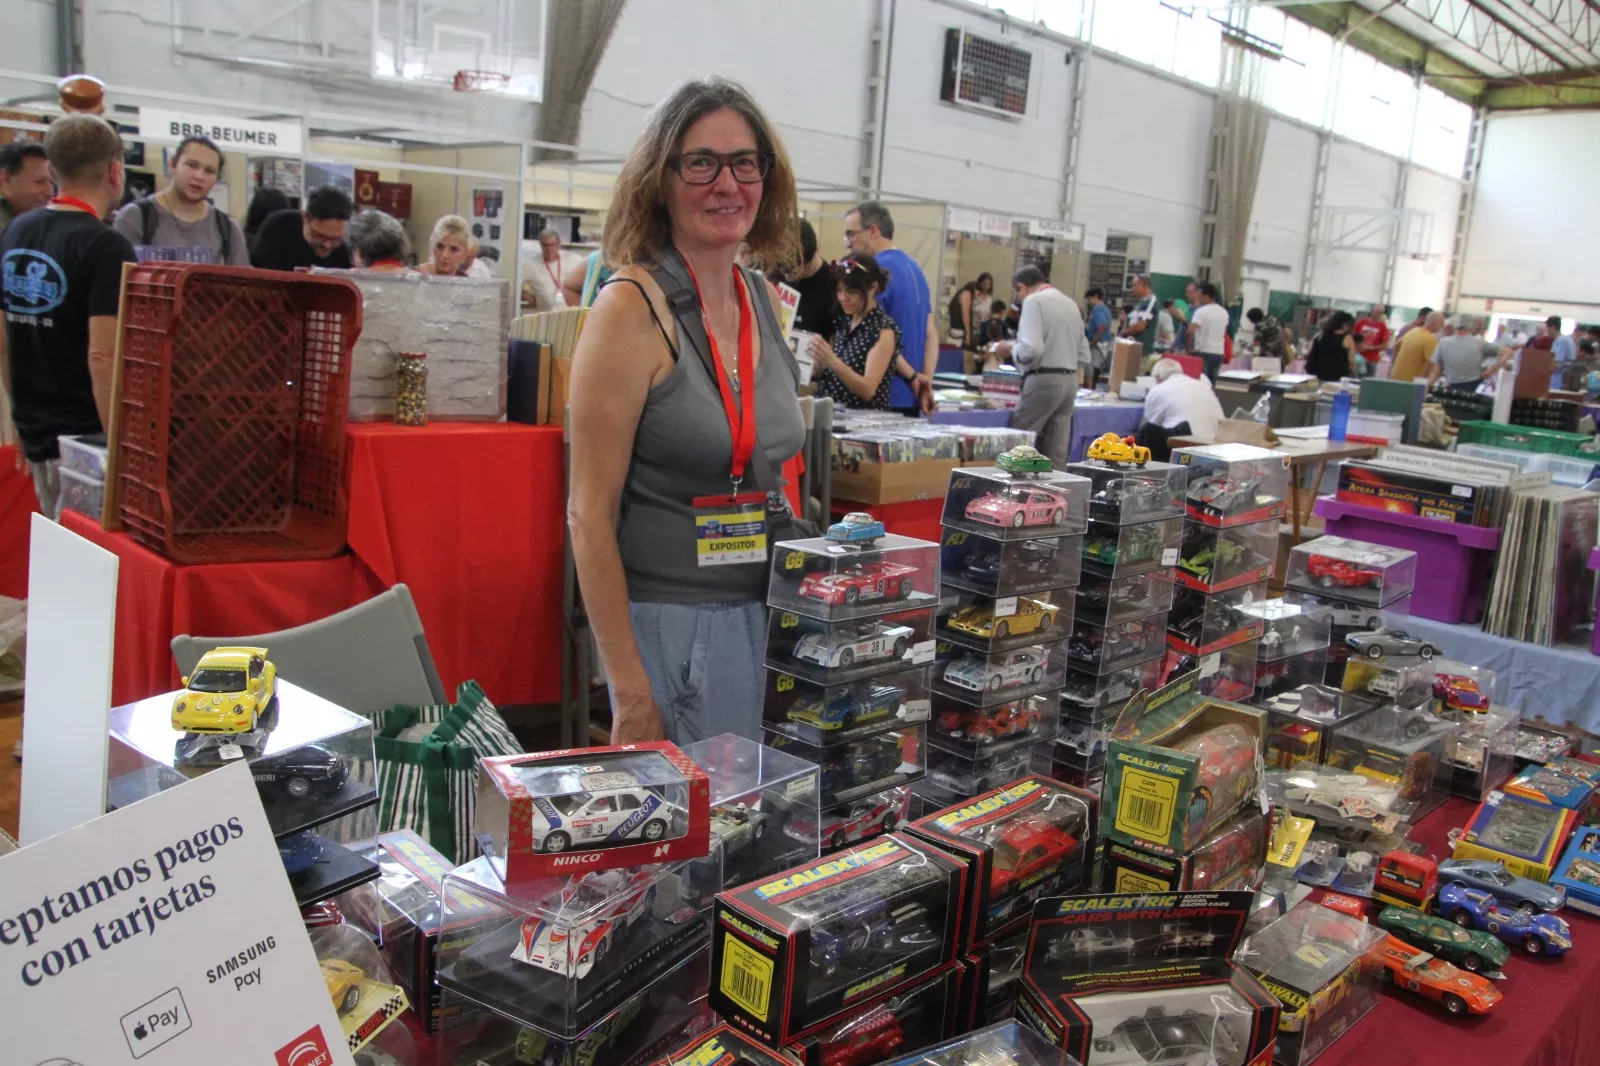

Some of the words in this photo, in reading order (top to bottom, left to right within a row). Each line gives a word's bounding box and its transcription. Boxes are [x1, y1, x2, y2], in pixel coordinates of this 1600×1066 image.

[170, 121, 278, 146] BBB-BEUMER
[710, 540, 756, 551] EXPOSITOR
[877, 580, 884, 593] 8
[1118, 752, 1188, 775] SCALEXTRIC
[616, 798, 653, 837] PEUGEOT
[935, 780, 1042, 830] SCALEXTRIC
[597, 824, 603, 834] 3
[553, 854, 601, 867] NINCO
[755, 840, 901, 899] SCALEXTRIC
[0, 858, 151, 947] eptamos
[154, 816, 244, 882] pagos
[1059, 894, 1178, 913] SCALEXTRIC
[1063, 911, 1112, 924] CARS
[1116, 909, 1162, 921] WITH
[1163, 907, 1219, 918] LIGHTS
[21, 936, 92, 988] con
[93, 874, 217, 950] tarjetas
[719, 909, 780, 950] SCALEXTRIC
[206, 935, 278, 985] SAMSUNG
[549, 961, 560, 972] 20
[845, 963, 908, 999] SCALEXTRIC
[1151, 972, 1184, 980] SCALEXTRIC
[1262, 980, 1307, 1008] EWALT
[148, 1006, 180, 1034] Pay
